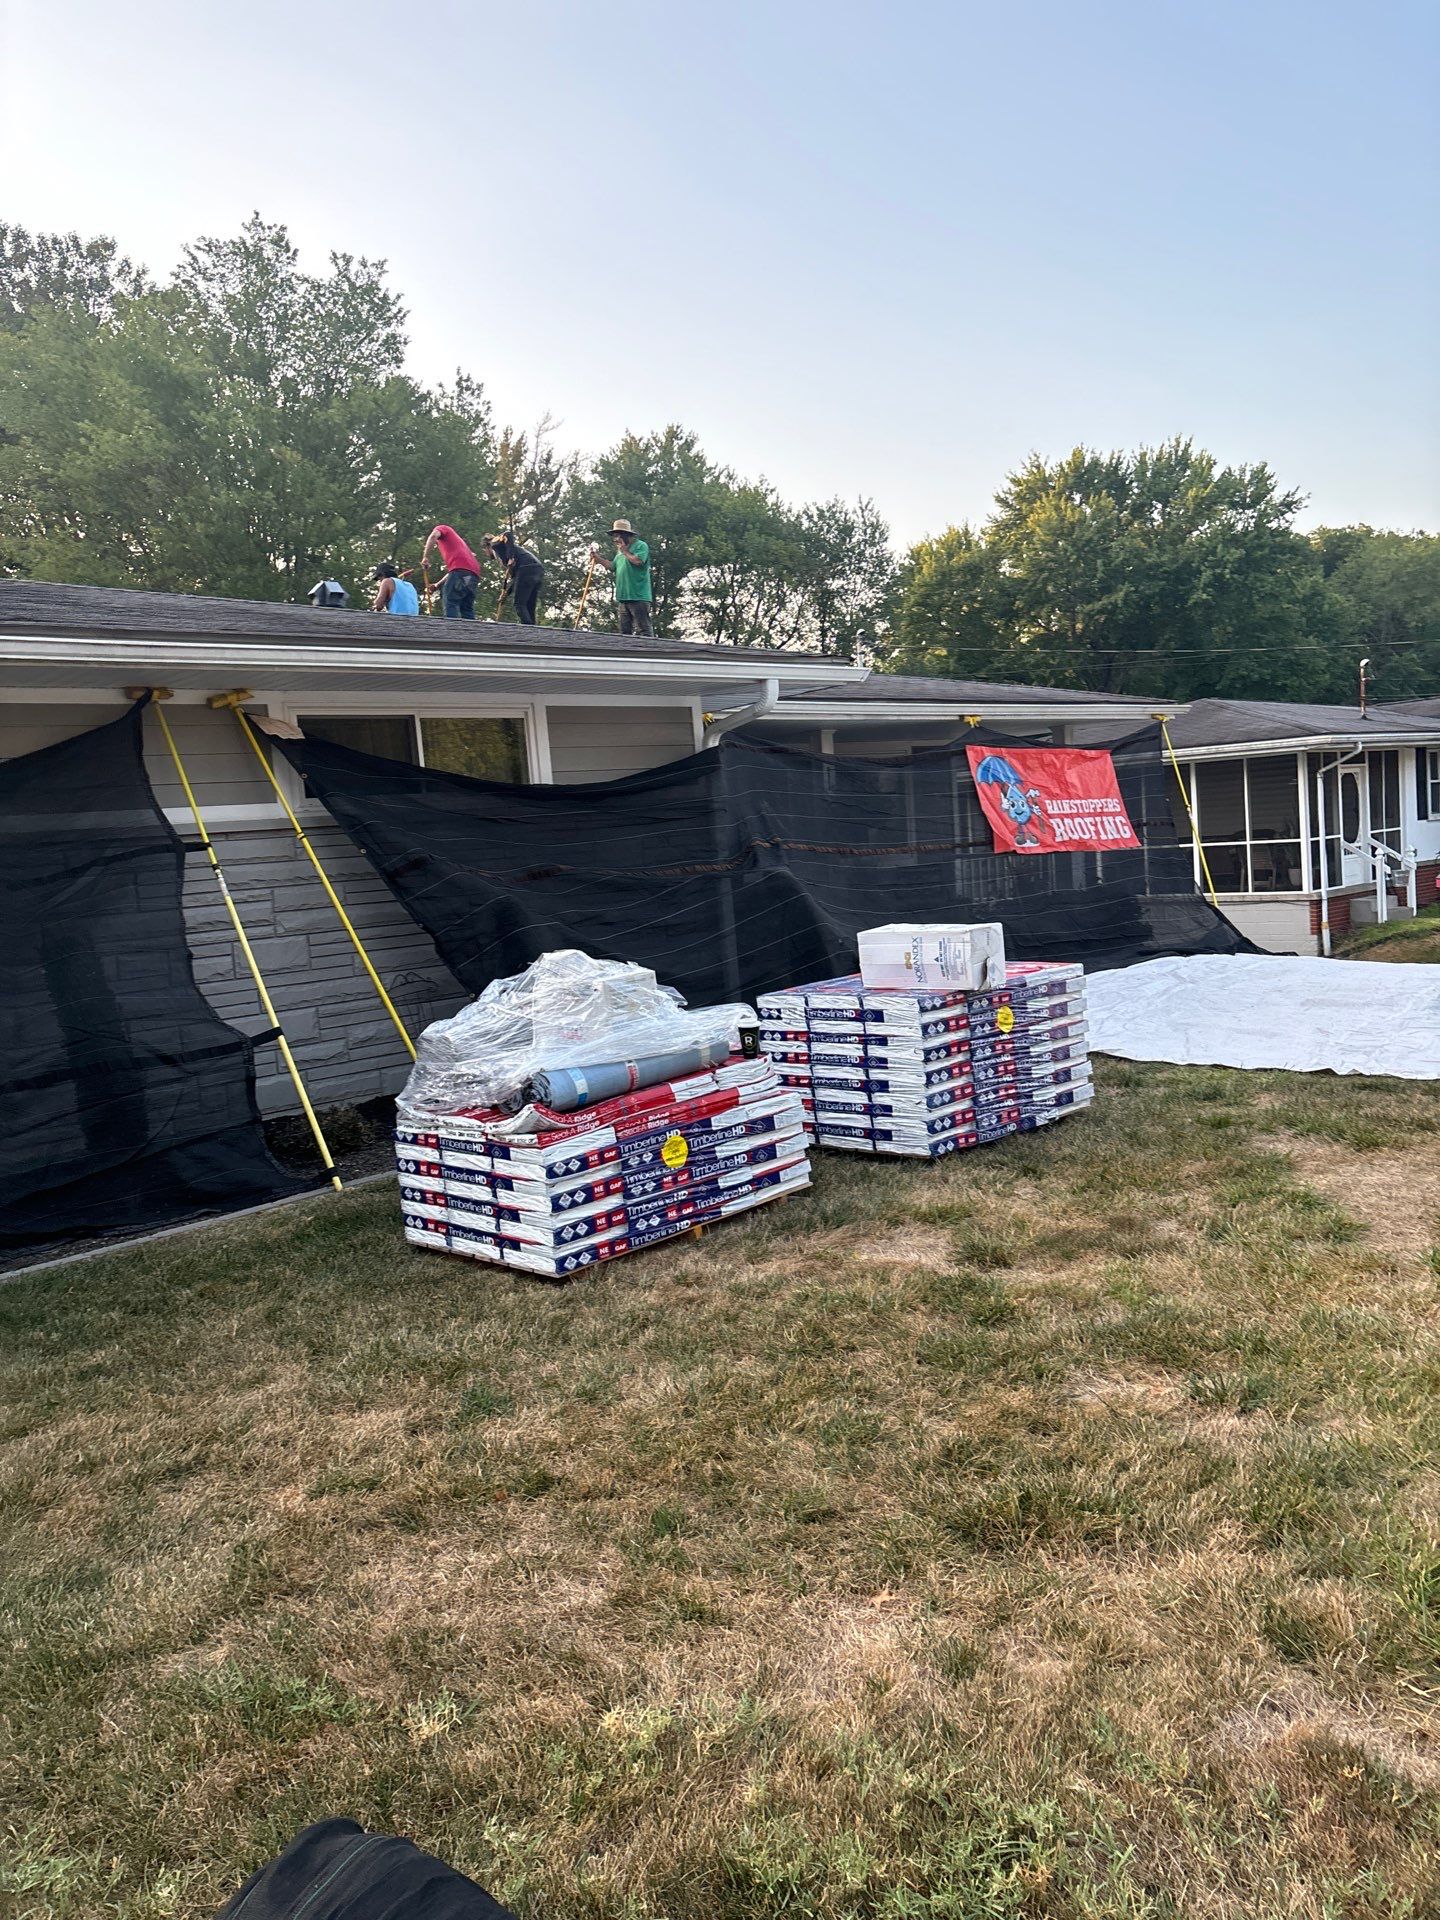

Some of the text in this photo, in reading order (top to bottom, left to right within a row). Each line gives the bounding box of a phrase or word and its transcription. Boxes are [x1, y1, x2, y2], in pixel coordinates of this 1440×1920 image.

[1045, 799, 1121, 814] RAINSTOPPERS
[1050, 816, 1132, 842] ROOFING
[912, 937, 923, 983] NORANDEX
[744, 1036, 753, 1045] R
[588, 1154, 599, 1162] NE
[604, 1151, 617, 1159] GAF
[677, 1172, 689, 1181] GAF
[609, 1181, 622, 1190] GAF
[667, 1209, 678, 1217] NE
[682, 1206, 694, 1214] GAF
[596, 1217, 607, 1225] NE
[612, 1213, 624, 1221] GAF
[599, 1246, 610, 1254] NE
[615, 1243, 627, 1251] GAF
